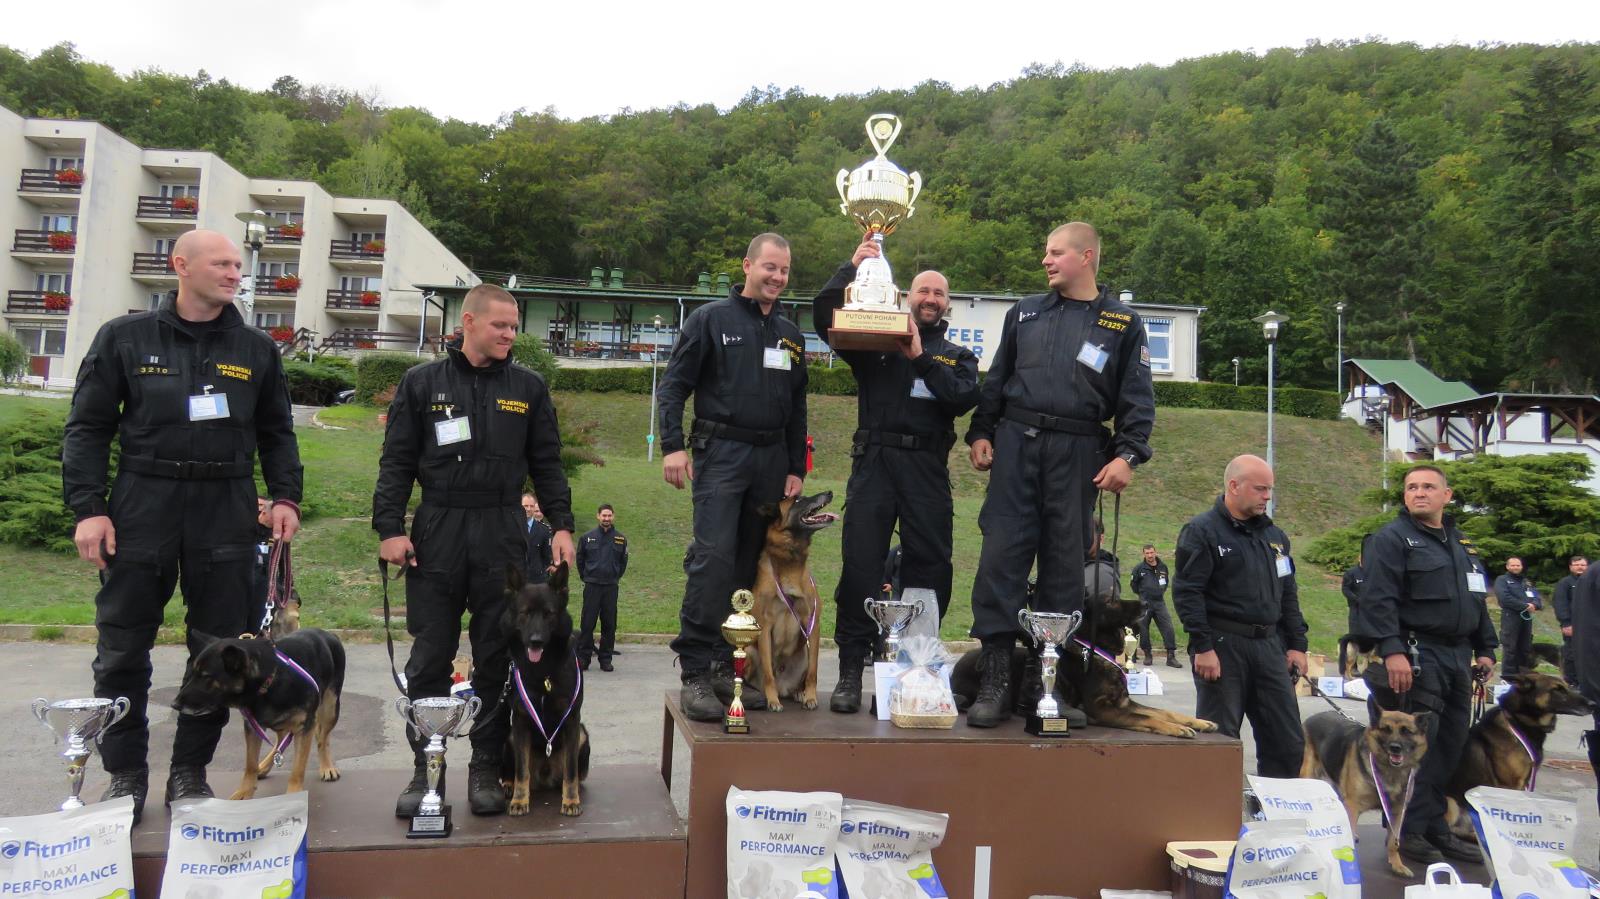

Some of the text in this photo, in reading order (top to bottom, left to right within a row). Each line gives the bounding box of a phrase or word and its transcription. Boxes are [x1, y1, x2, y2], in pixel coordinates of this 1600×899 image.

[1100, 311, 1132, 322] POLICIE
[1097, 319, 1127, 331] 273257
[222, 370, 249, 381] POLICIE
[501, 405, 526, 414] POLICIE
[1275, 797, 1313, 811] Fitmin
[753, 805, 808, 823] Fitmin
[1490, 807, 1542, 824] Fitmin
[202, 825, 265, 843] Fitmin
[768, 832, 794, 841] MAXI
[858, 822, 910, 839] Fitmin
[1509, 831, 1533, 839] MAXI
[24, 835, 91, 858] Fitmin
[740, 840, 826, 856] PERFORMANCE
[872, 842, 896, 851] MAXI
[1258, 844, 1297, 862] Fitmin
[220, 850, 252, 863] MAXI
[43, 864, 77, 879] MAXI
[180, 855, 291, 875] PERFORMANCE
[2, 863, 118, 894] PERFORMANCE
[1241, 871, 1319, 888] PERFORMANCE
